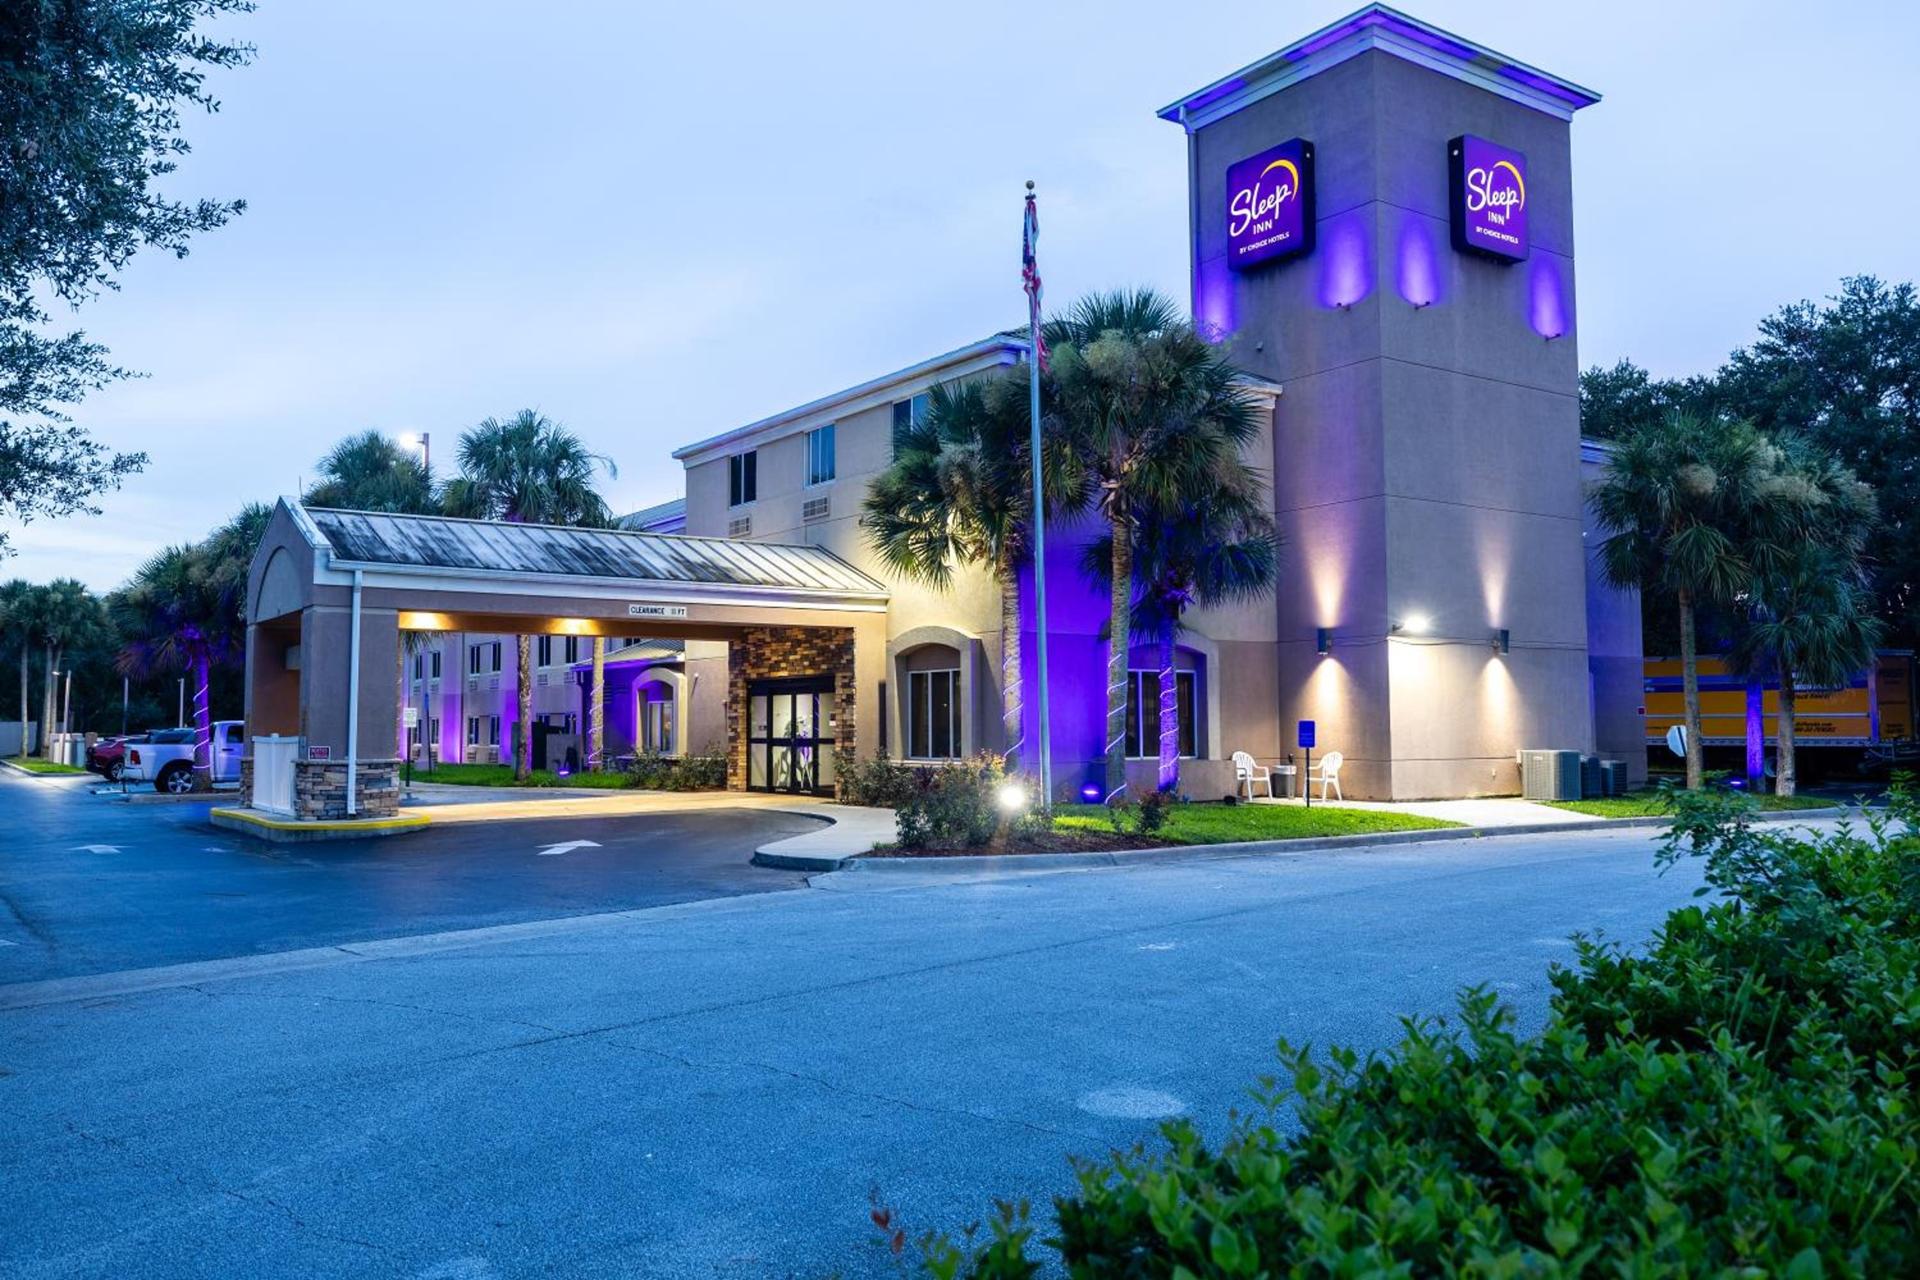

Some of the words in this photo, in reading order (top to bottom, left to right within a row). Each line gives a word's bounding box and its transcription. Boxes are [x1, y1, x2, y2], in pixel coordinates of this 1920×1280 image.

[1467, 168, 1519, 219] Sleep
[1230, 182, 1291, 237] Sleep
[1488, 211, 1505, 225] INN
[1253, 219, 1273, 235] INN
[1483, 228, 1501, 239] CHOICE
[1239, 246, 1247, 254] BY
[1247, 239, 1268, 251] CHOICE
[1268, 231, 1290, 244] HOTELS
[630, 606, 665, 615] CLEARANCE
